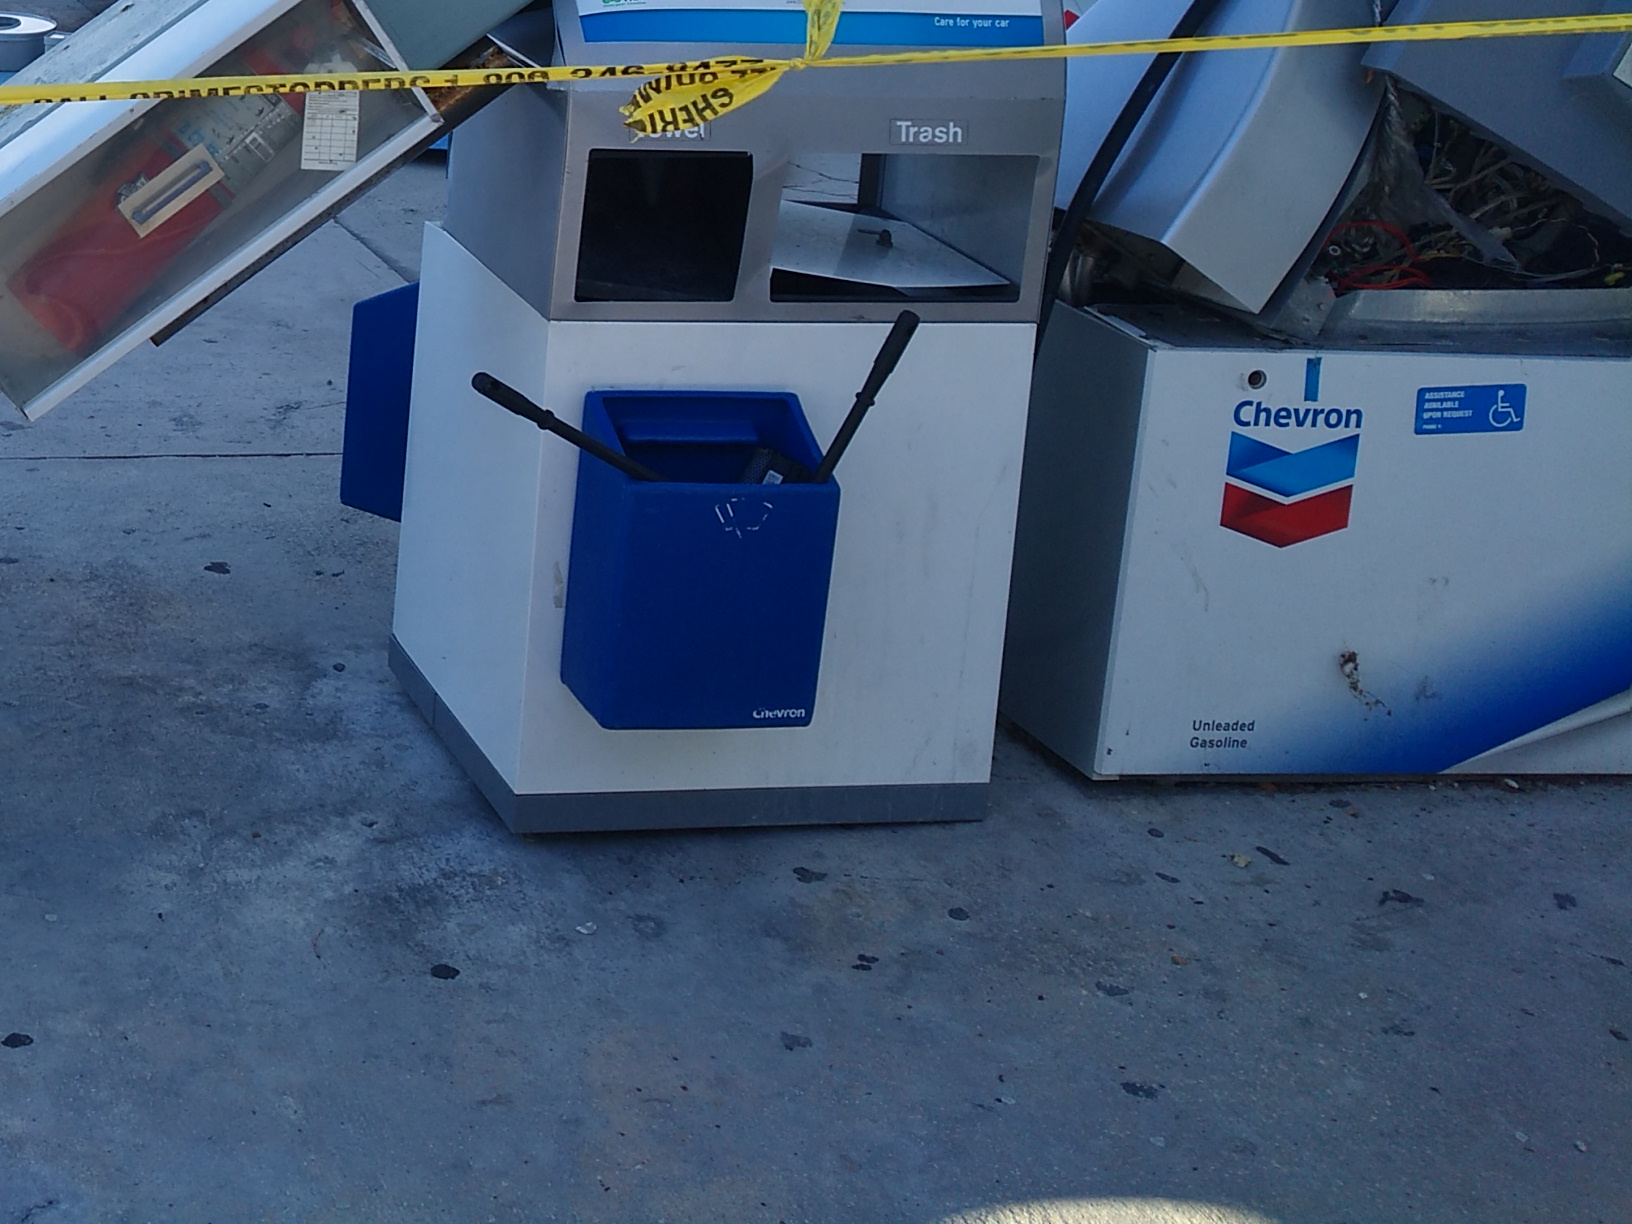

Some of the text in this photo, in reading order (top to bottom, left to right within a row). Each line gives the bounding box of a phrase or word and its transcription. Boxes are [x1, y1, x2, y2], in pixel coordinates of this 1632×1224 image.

[934, 17, 1010, 28] Care for your car
[896, 120, 962, 143] Trash
[1424, 390, 1466, 399] ASSISTANCE
[1423, 401, 1459, 409] AVAILABLE
[1233, 399, 1364, 429] Chevron
[1422, 410, 1473, 419] UPON REQUEST
[752, 707, 805, 719] Chevron
[1192, 719, 1256, 732] Unleaded
[1190, 736, 1248, 749] Gasoline
